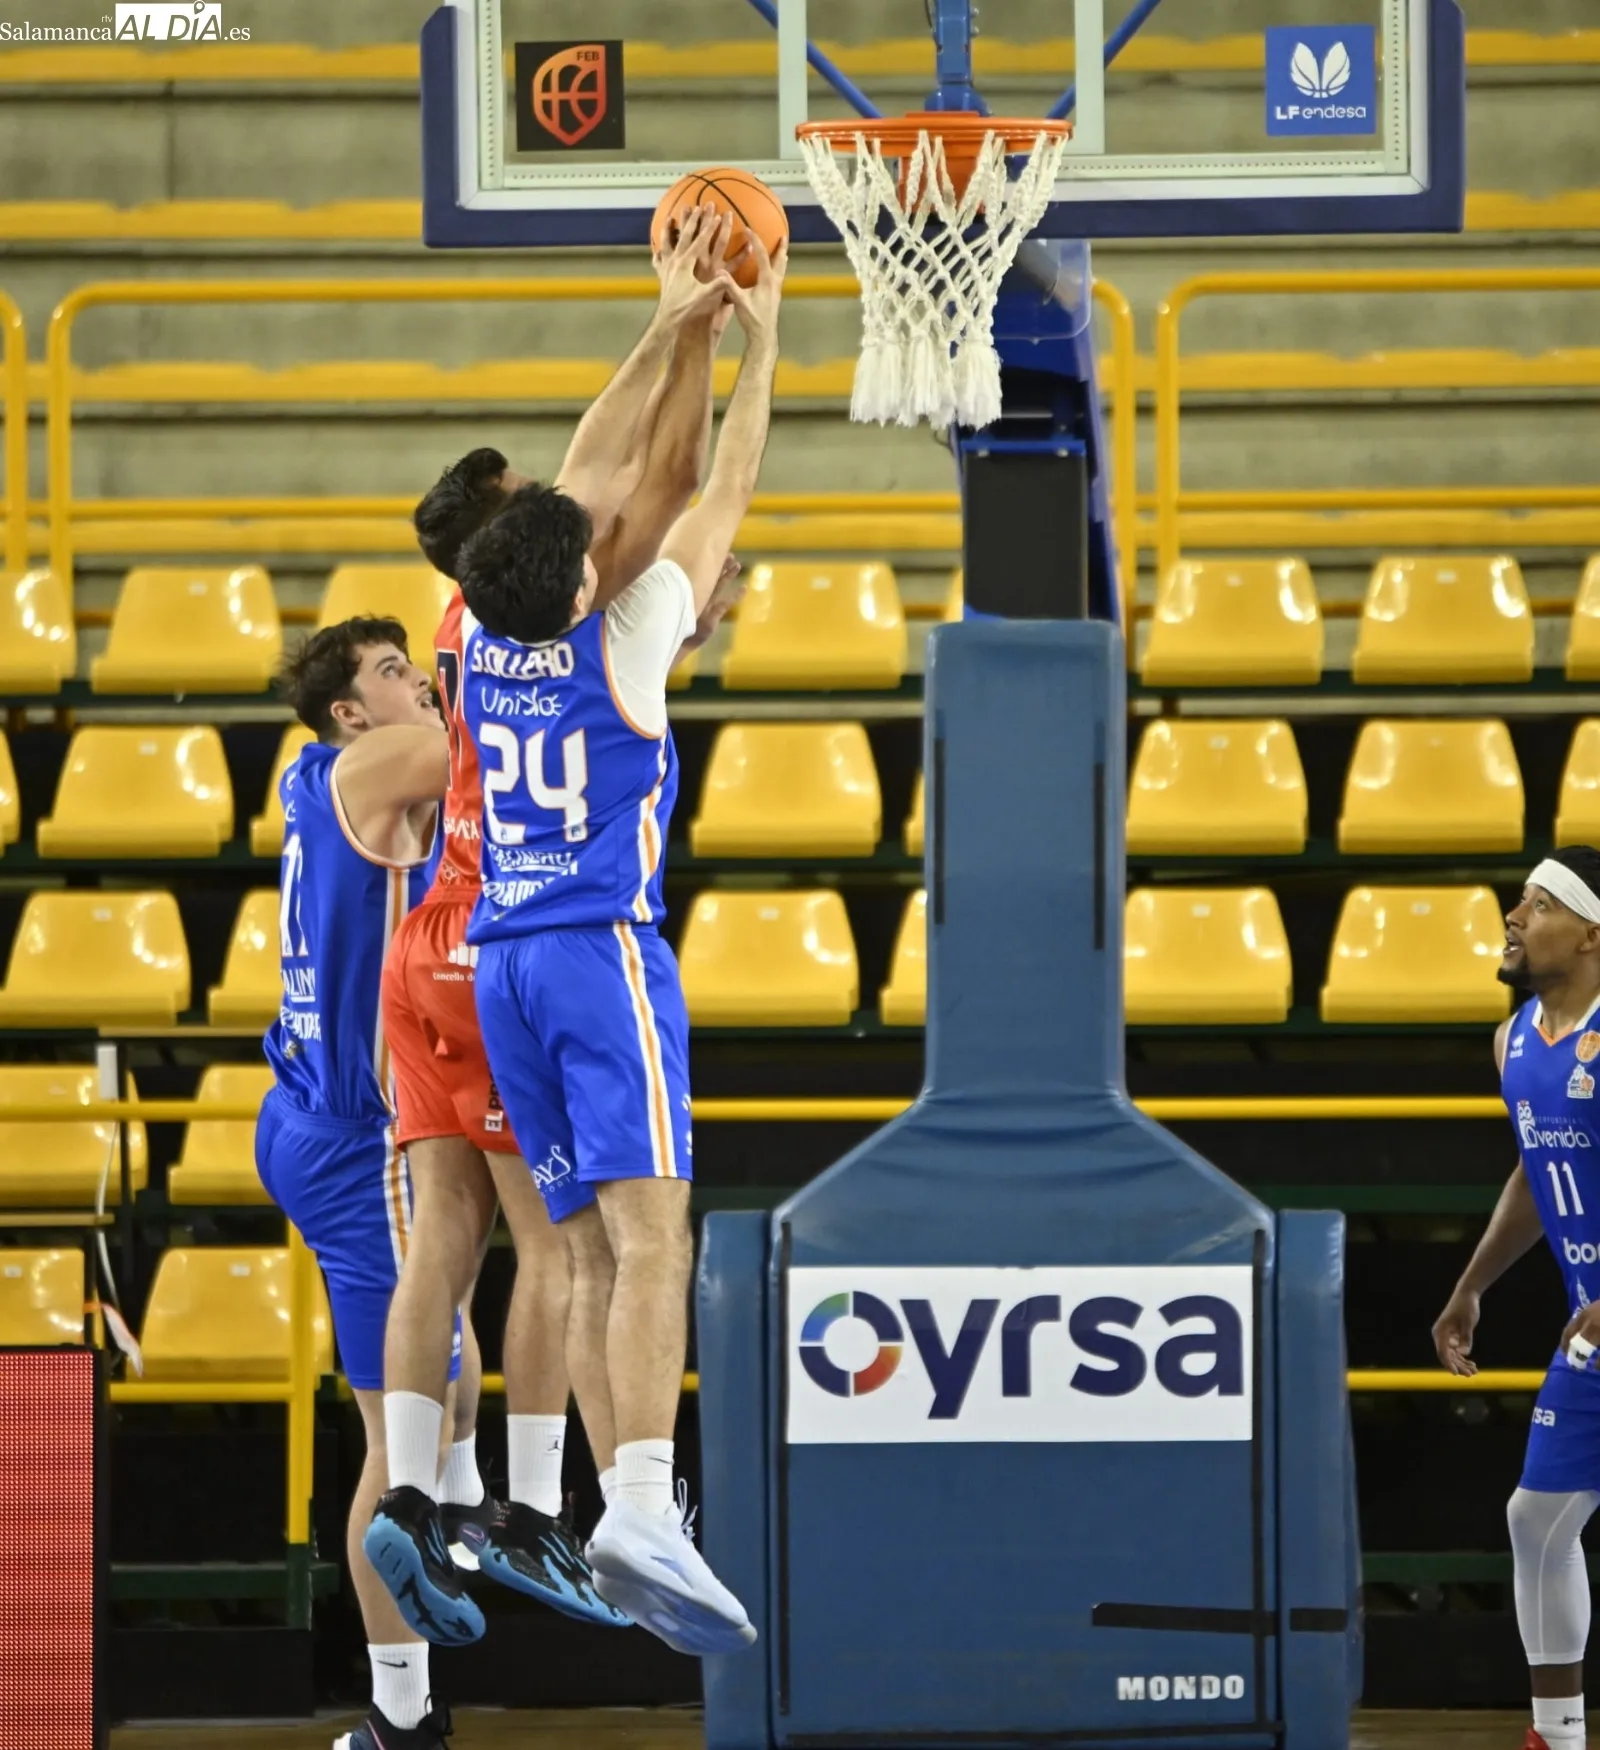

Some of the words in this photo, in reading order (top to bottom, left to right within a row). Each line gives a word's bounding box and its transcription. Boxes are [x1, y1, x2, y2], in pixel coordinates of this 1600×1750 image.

[576, 51, 600, 61] FEB
[1276, 105, 1300, 120] LF
[1302, 104, 1366, 119] endesa
[480, 722, 588, 844] 24
[1547, 1161, 1585, 1217] 11
[1563, 1237, 1600, 1265] bo
[1117, 1675, 1245, 1701] MONDO
